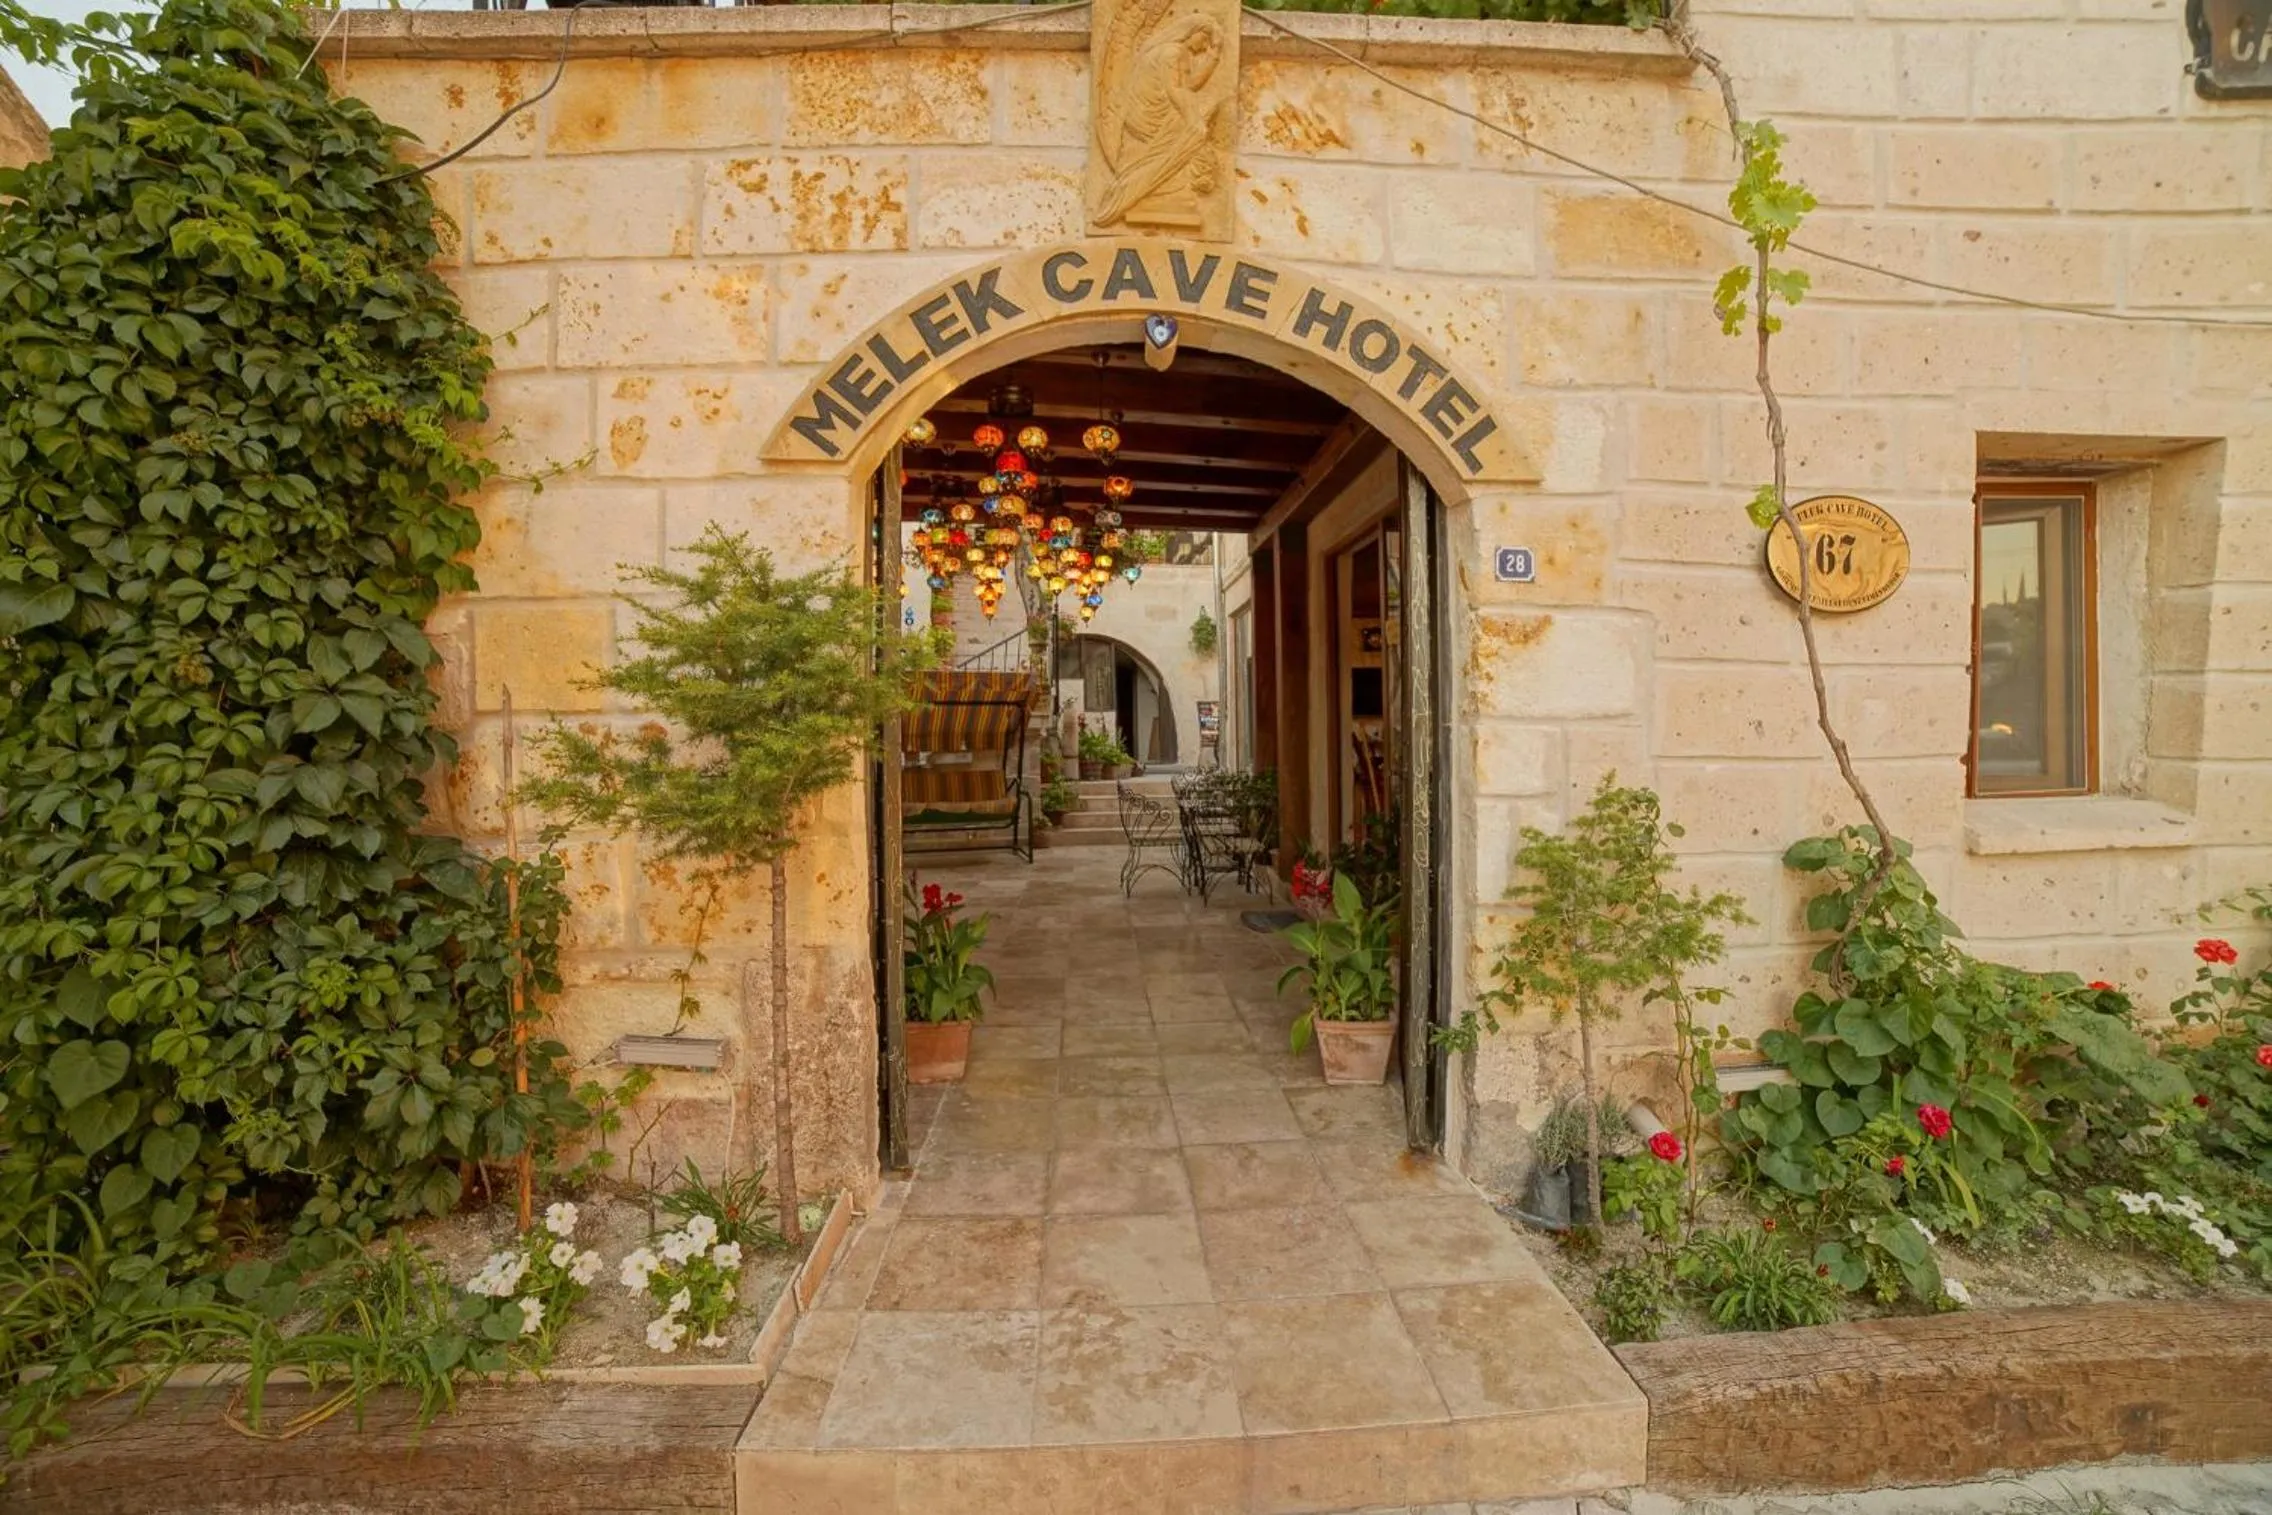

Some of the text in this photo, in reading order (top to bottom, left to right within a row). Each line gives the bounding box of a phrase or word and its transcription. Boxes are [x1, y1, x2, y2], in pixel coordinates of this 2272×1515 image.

[789, 248, 1498, 476] MELEK CAVE HOTEL
[1856, 505, 1888, 531] HOTEL
[1506, 554, 1525, 573] 28
[1815, 533, 1856, 576] 67
